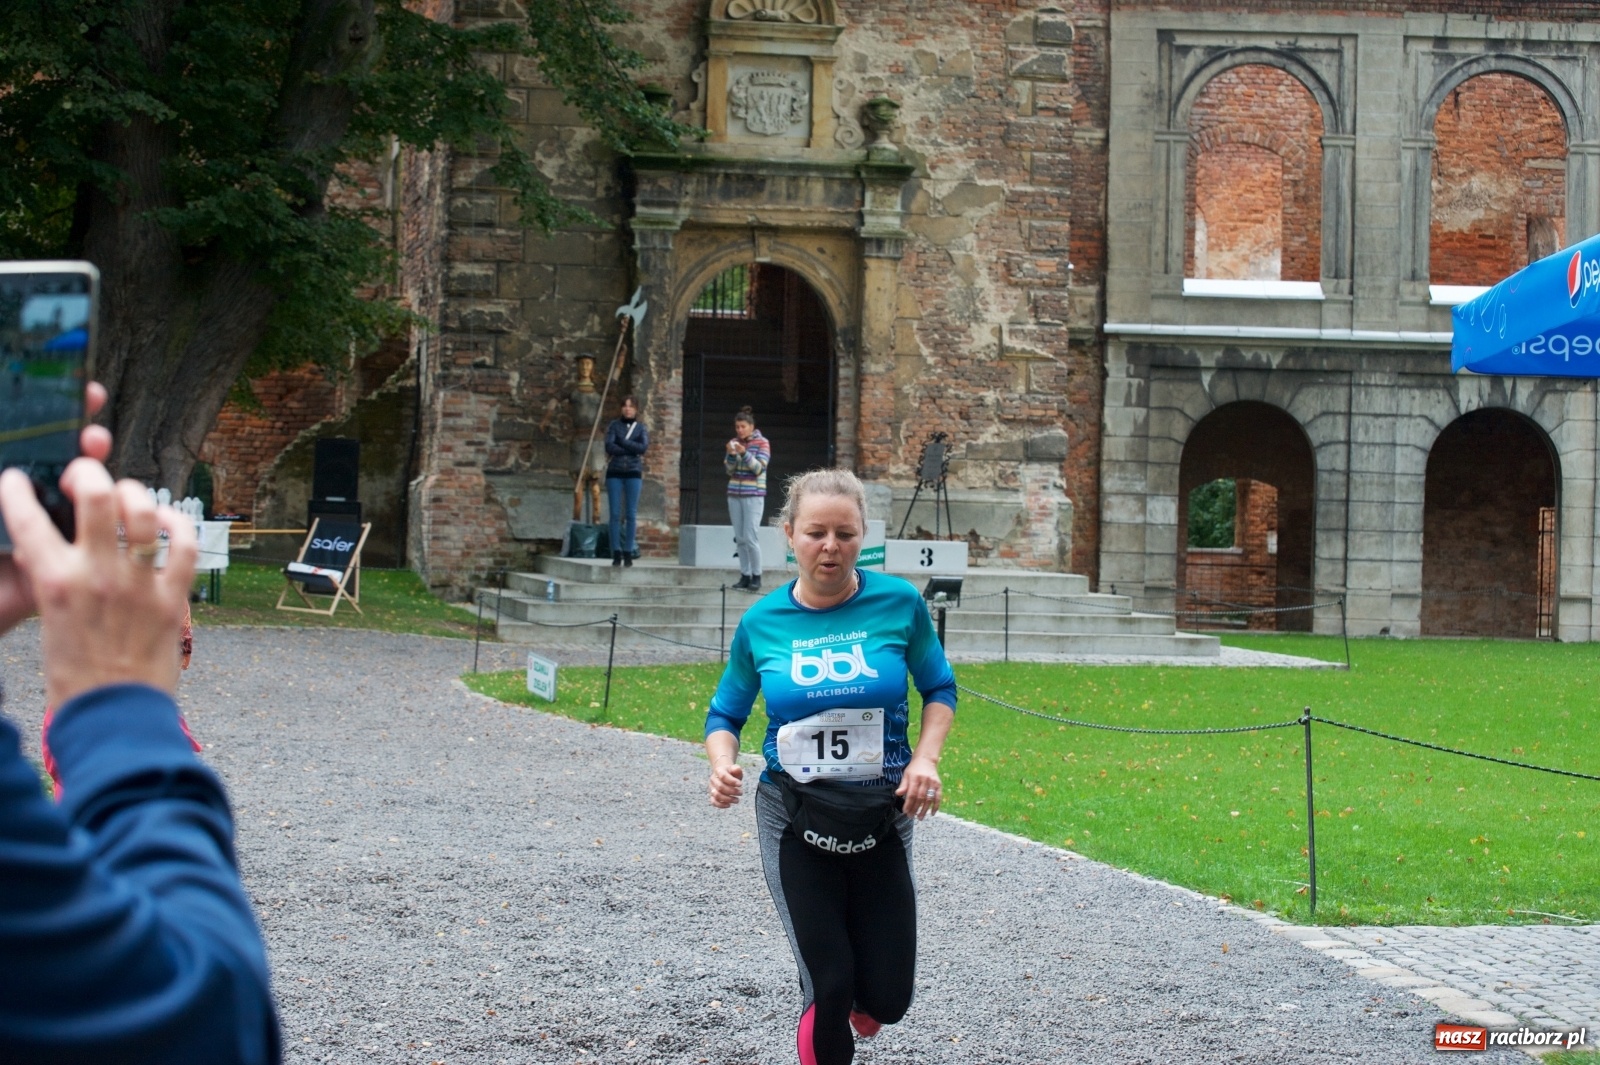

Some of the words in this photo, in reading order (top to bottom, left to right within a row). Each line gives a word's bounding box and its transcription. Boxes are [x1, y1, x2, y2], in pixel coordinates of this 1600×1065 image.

[311, 536, 355, 552] safer
[920, 547, 933, 567] 3
[791, 644, 879, 686] bbl
[806, 686, 866, 699] RACIBÓRZ
[811, 730, 849, 760] 15
[803, 830, 877, 854] adidas
